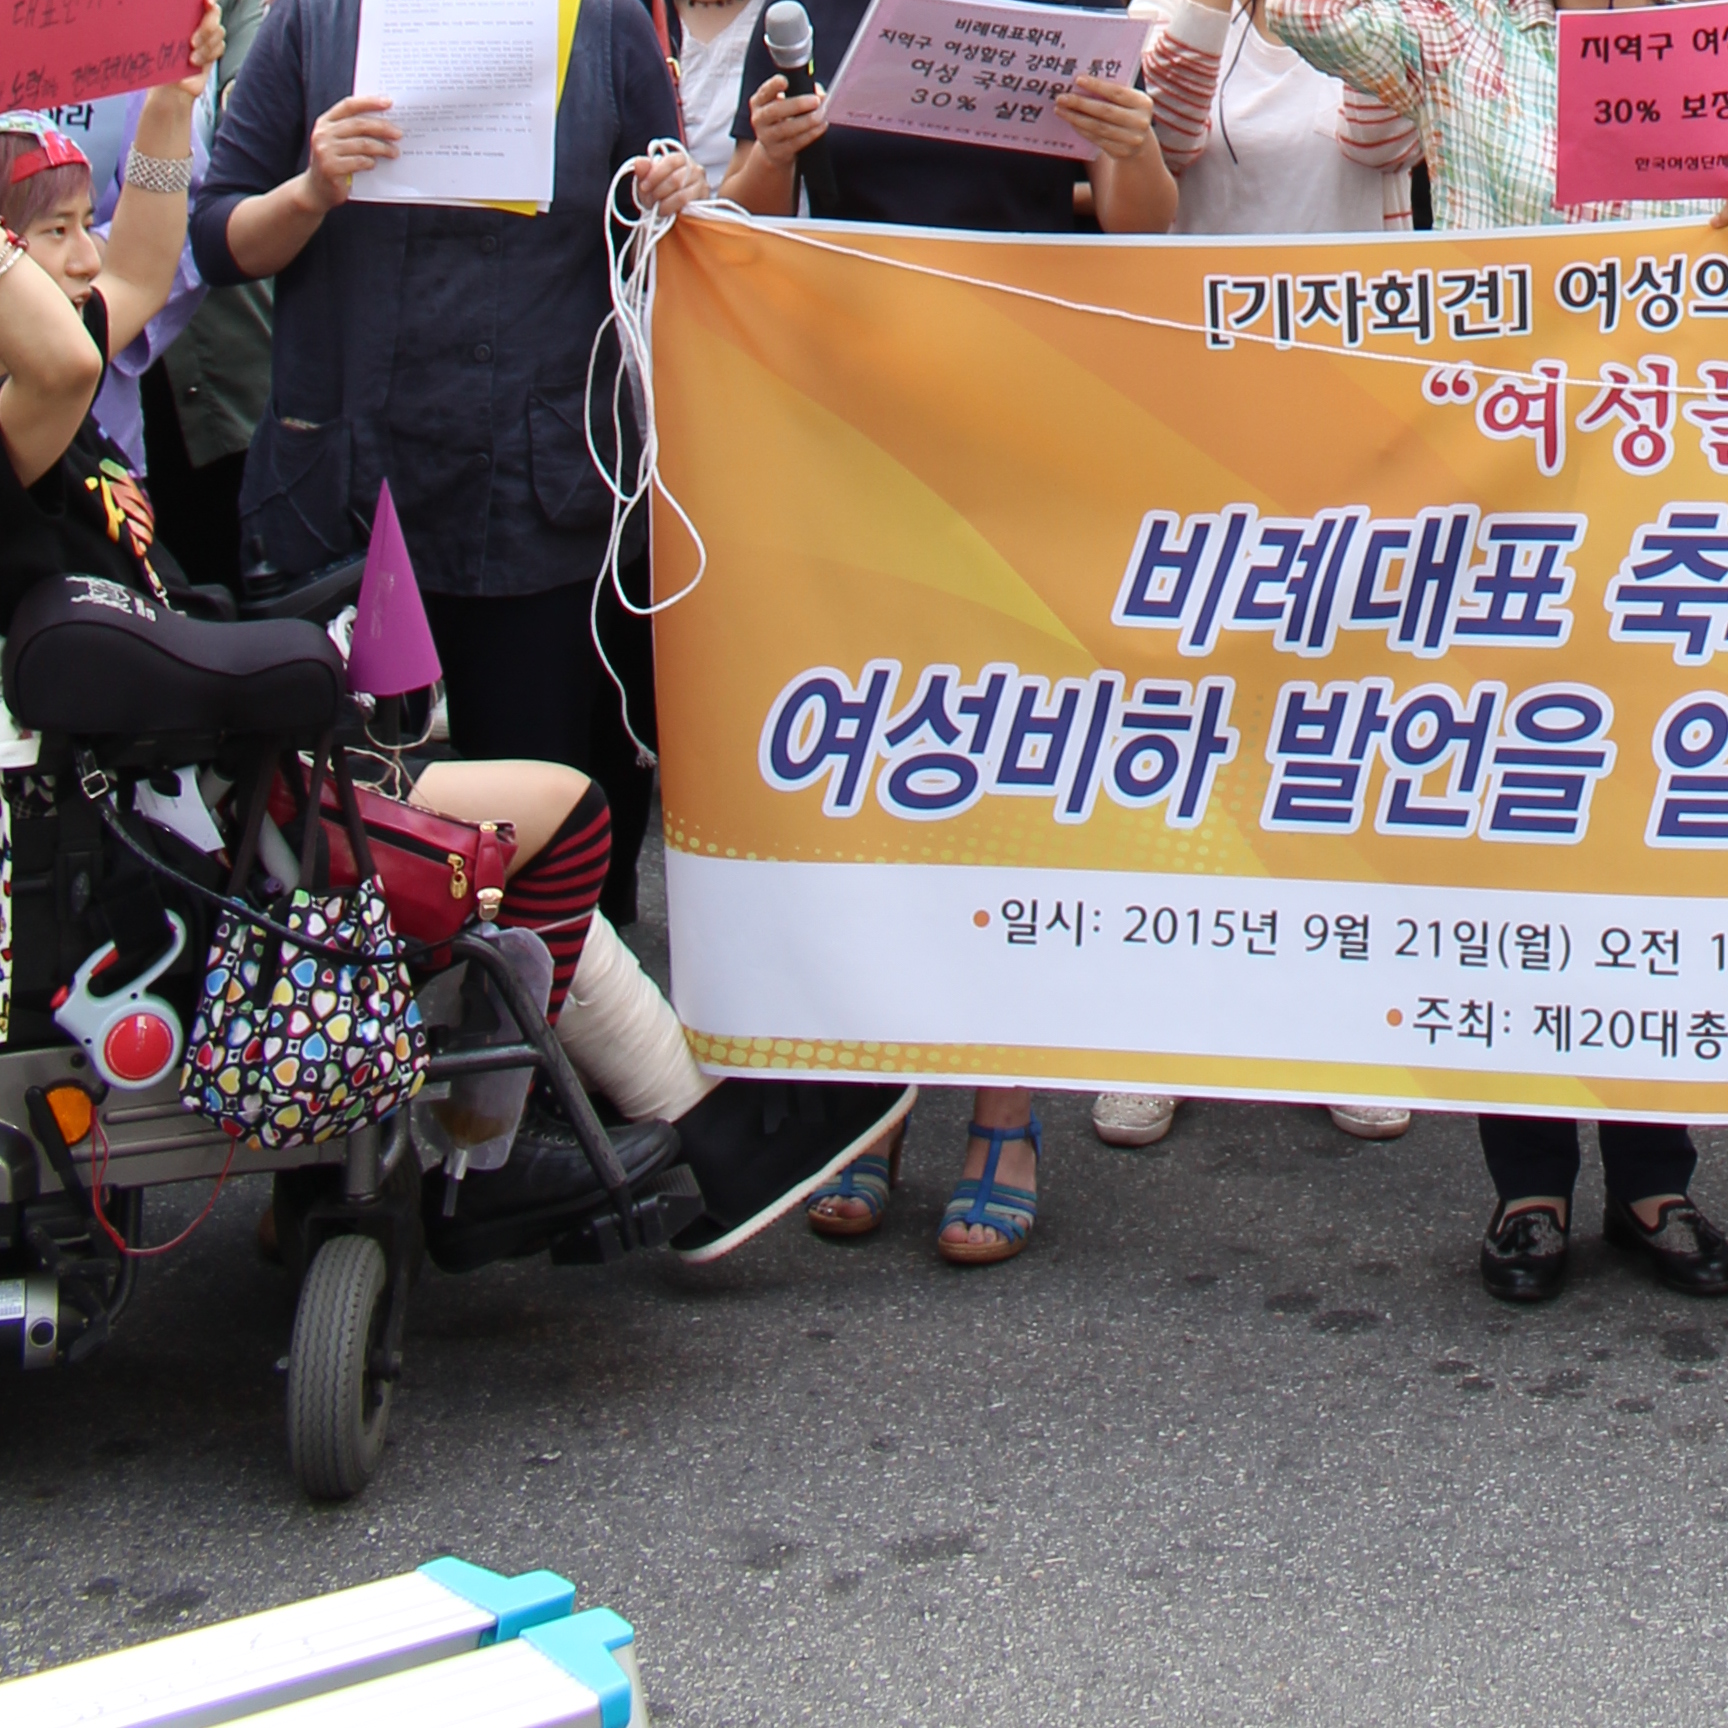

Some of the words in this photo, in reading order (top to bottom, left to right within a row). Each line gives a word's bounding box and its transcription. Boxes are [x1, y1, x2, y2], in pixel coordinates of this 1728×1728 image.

[878, 27, 933, 51] 지역구
[944, 39, 1017, 66] 여성할당
[1025, 53, 1078, 77] 강화를
[1086, 58, 1123, 79] 통한
[1581, 32, 1675, 65] 지역구
[910, 57, 960, 85] 여성
[972, 69, 1075, 101] 국회의원
[910, 87, 978, 113] 30%
[993, 99, 1044, 124] 실현
[1593, 98, 1662, 125] 30%
[1208, 267, 1531, 345] [기자회견]
[1122, 510, 1577, 648] 비례대표
[772, 671, 1229, 819] 여성비하
[1272, 686, 1608, 835] 발언을
[1001, 898, 1103, 947] 일시:
[1122, 904, 1279, 957] 2015년
[1302, 911, 1373, 961] 9월
[1393, 918, 1573, 972] 21일(월)
[1597, 925, 1682, 978] 오전
[1412, 996, 1514, 1050] 주최:
